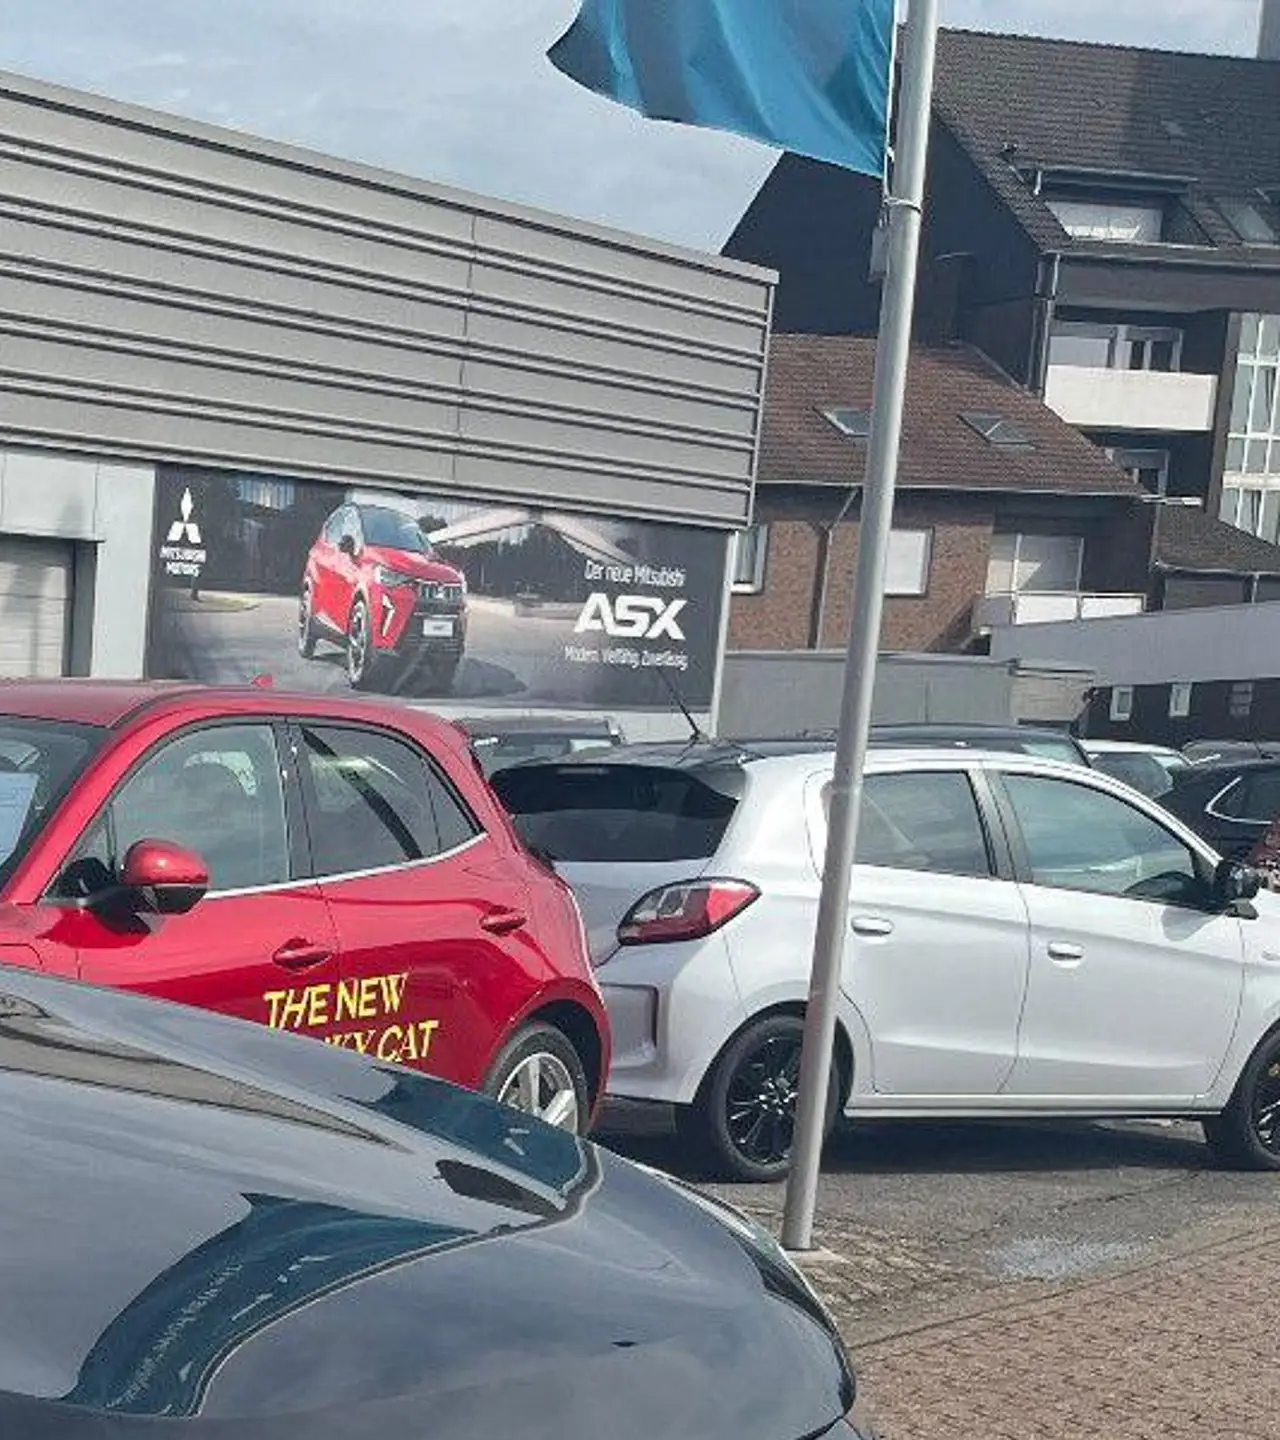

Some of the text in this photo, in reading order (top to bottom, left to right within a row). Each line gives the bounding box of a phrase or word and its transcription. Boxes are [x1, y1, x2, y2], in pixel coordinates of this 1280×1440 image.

[583, 558, 687, 587] Der neue Mitsubishi
[573, 592, 689, 641] ASX
[263, 971, 410, 1030] THE NEW
[376, 1019, 440, 1062] CAT
